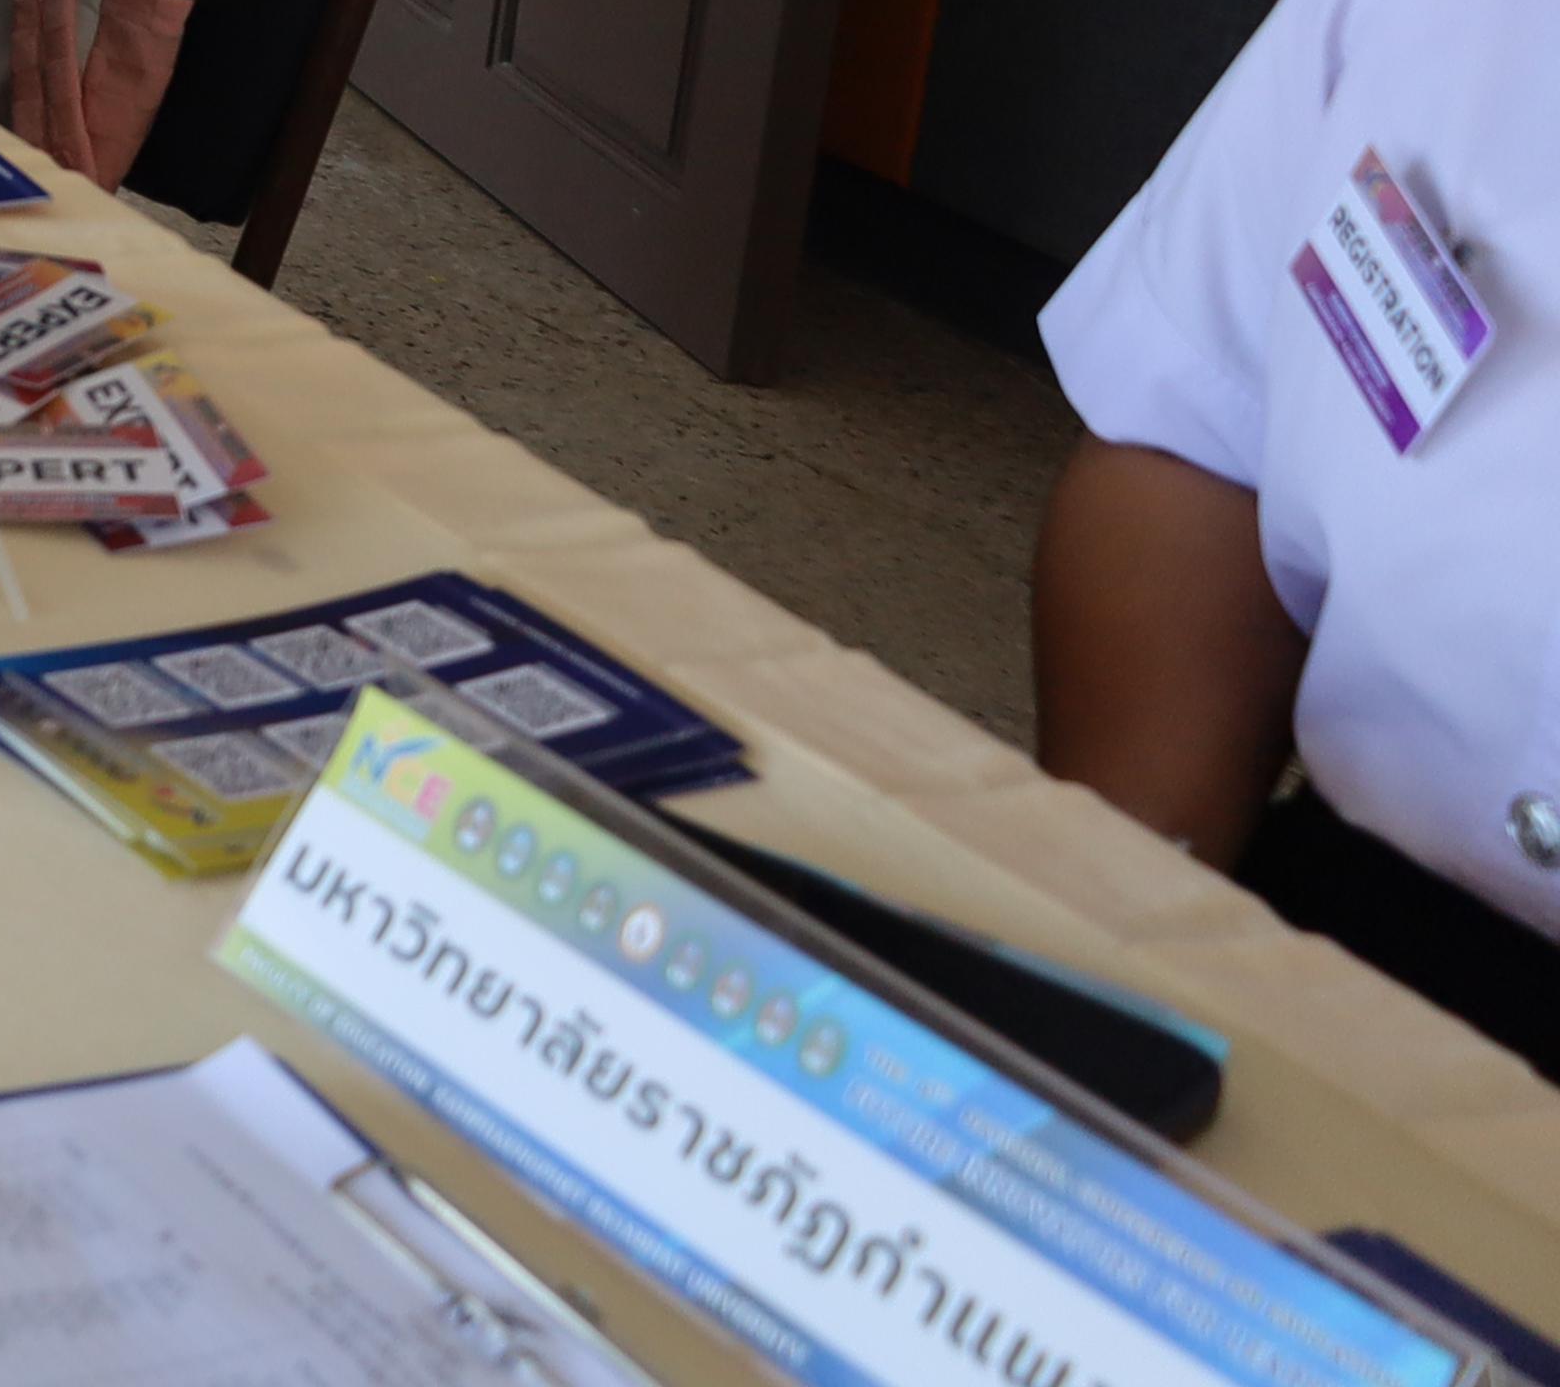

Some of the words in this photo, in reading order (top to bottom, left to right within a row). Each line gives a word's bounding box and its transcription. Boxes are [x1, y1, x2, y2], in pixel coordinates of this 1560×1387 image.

[1328, 203, 1448, 396] REGISTRATION
[282, 837, 1110, 1387] มหาวิทยาลัยราชภัฏกำแพ
